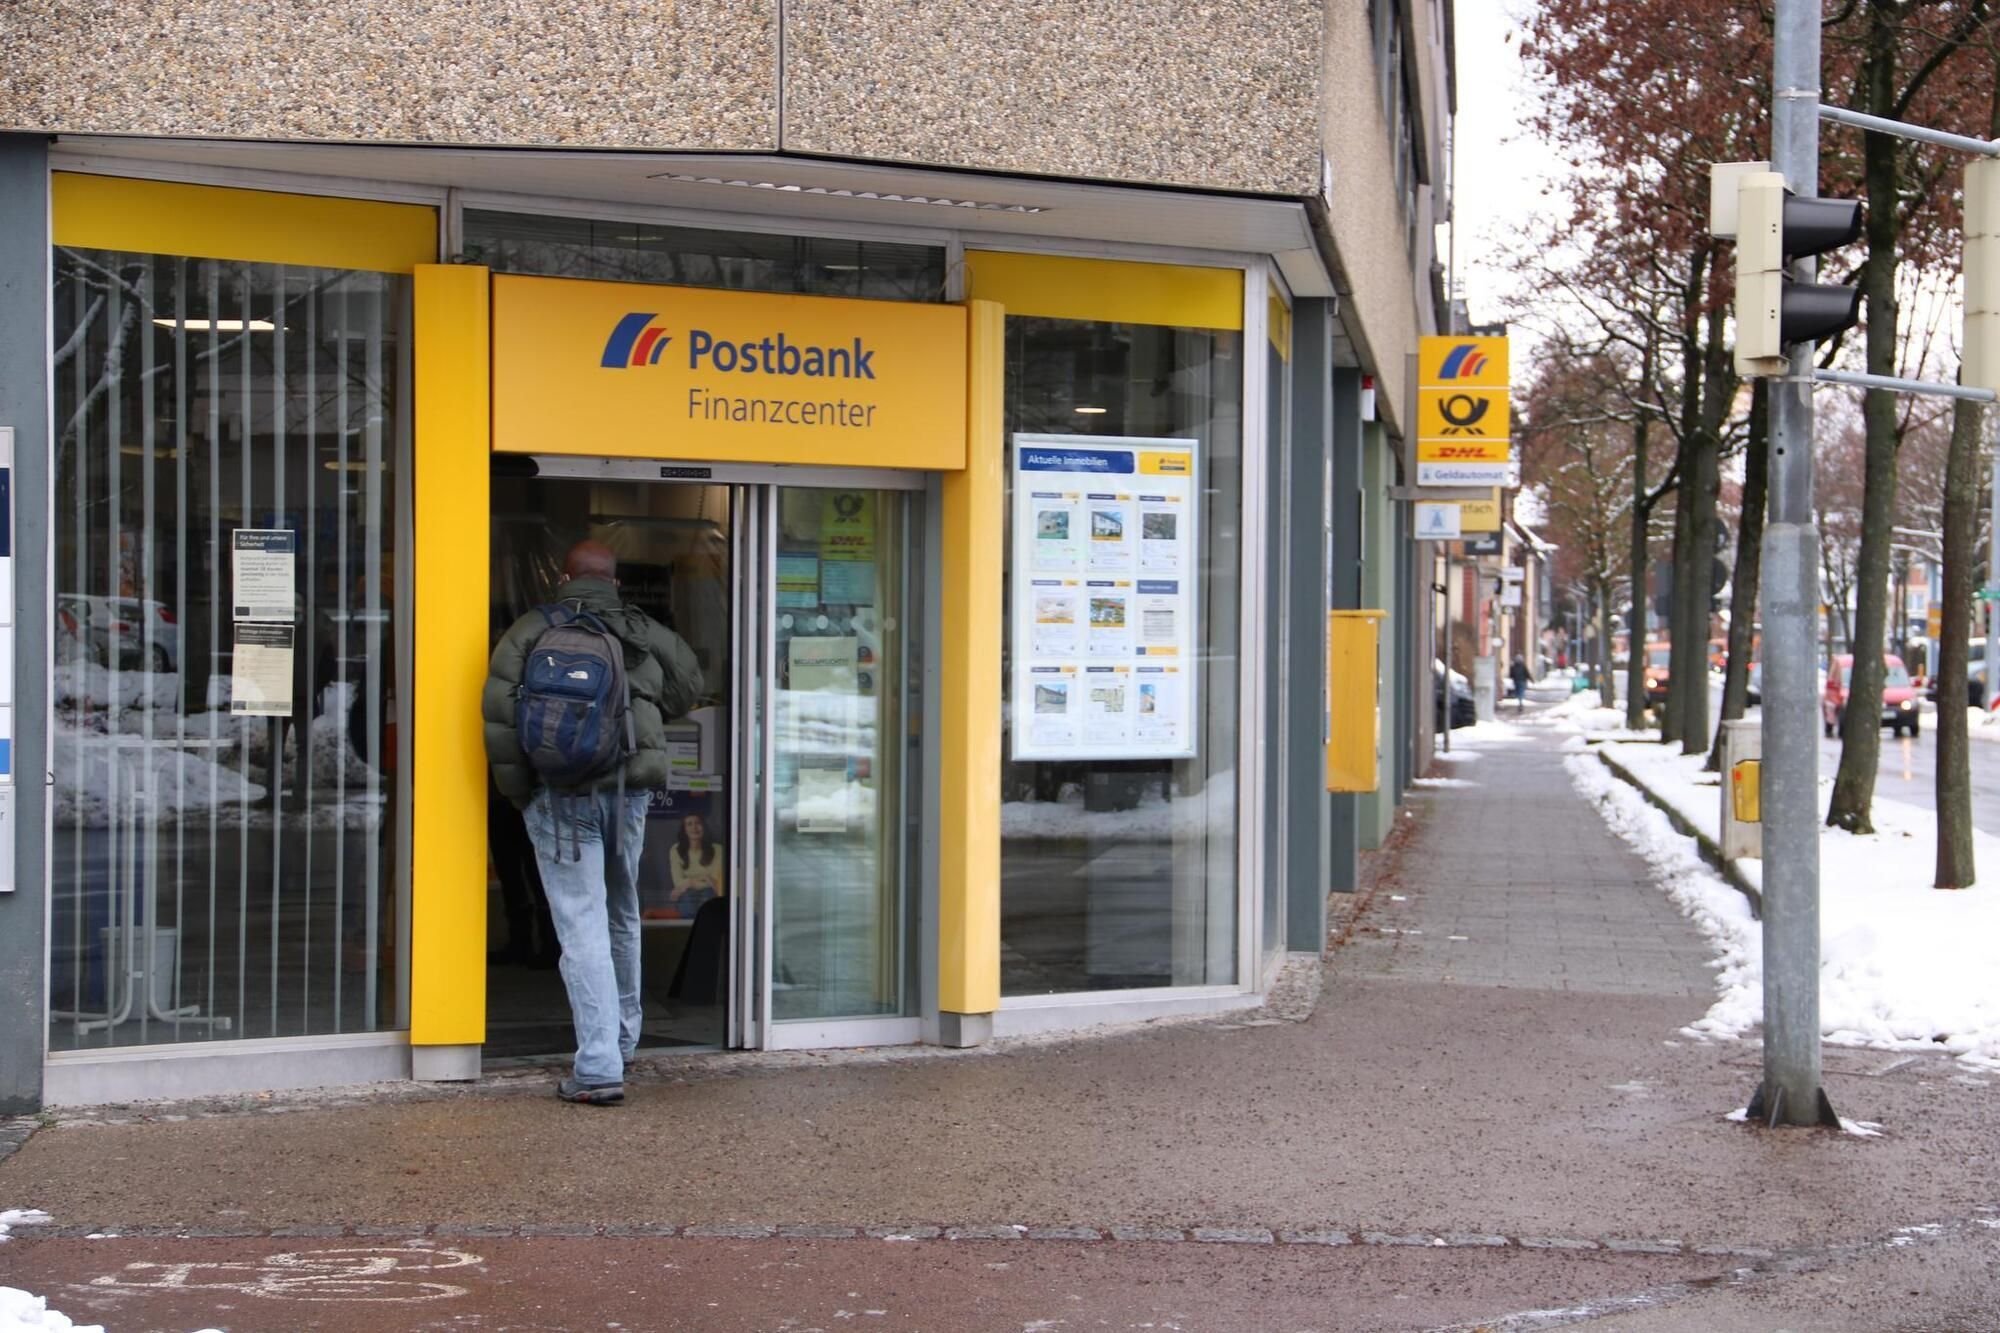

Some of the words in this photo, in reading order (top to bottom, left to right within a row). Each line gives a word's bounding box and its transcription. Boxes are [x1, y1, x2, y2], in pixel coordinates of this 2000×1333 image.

[689, 329, 876, 379] Postbank
[689, 388, 877, 427] Finanzcenter
[1439, 447, 1485, 458] DHL
[1027, 454, 1062, 465] Aktuelle
[1063, 455, 1109, 467] Immobilien
[1435, 470, 1503, 480] Geldautomat
[1462, 503, 1493, 513] tfach
